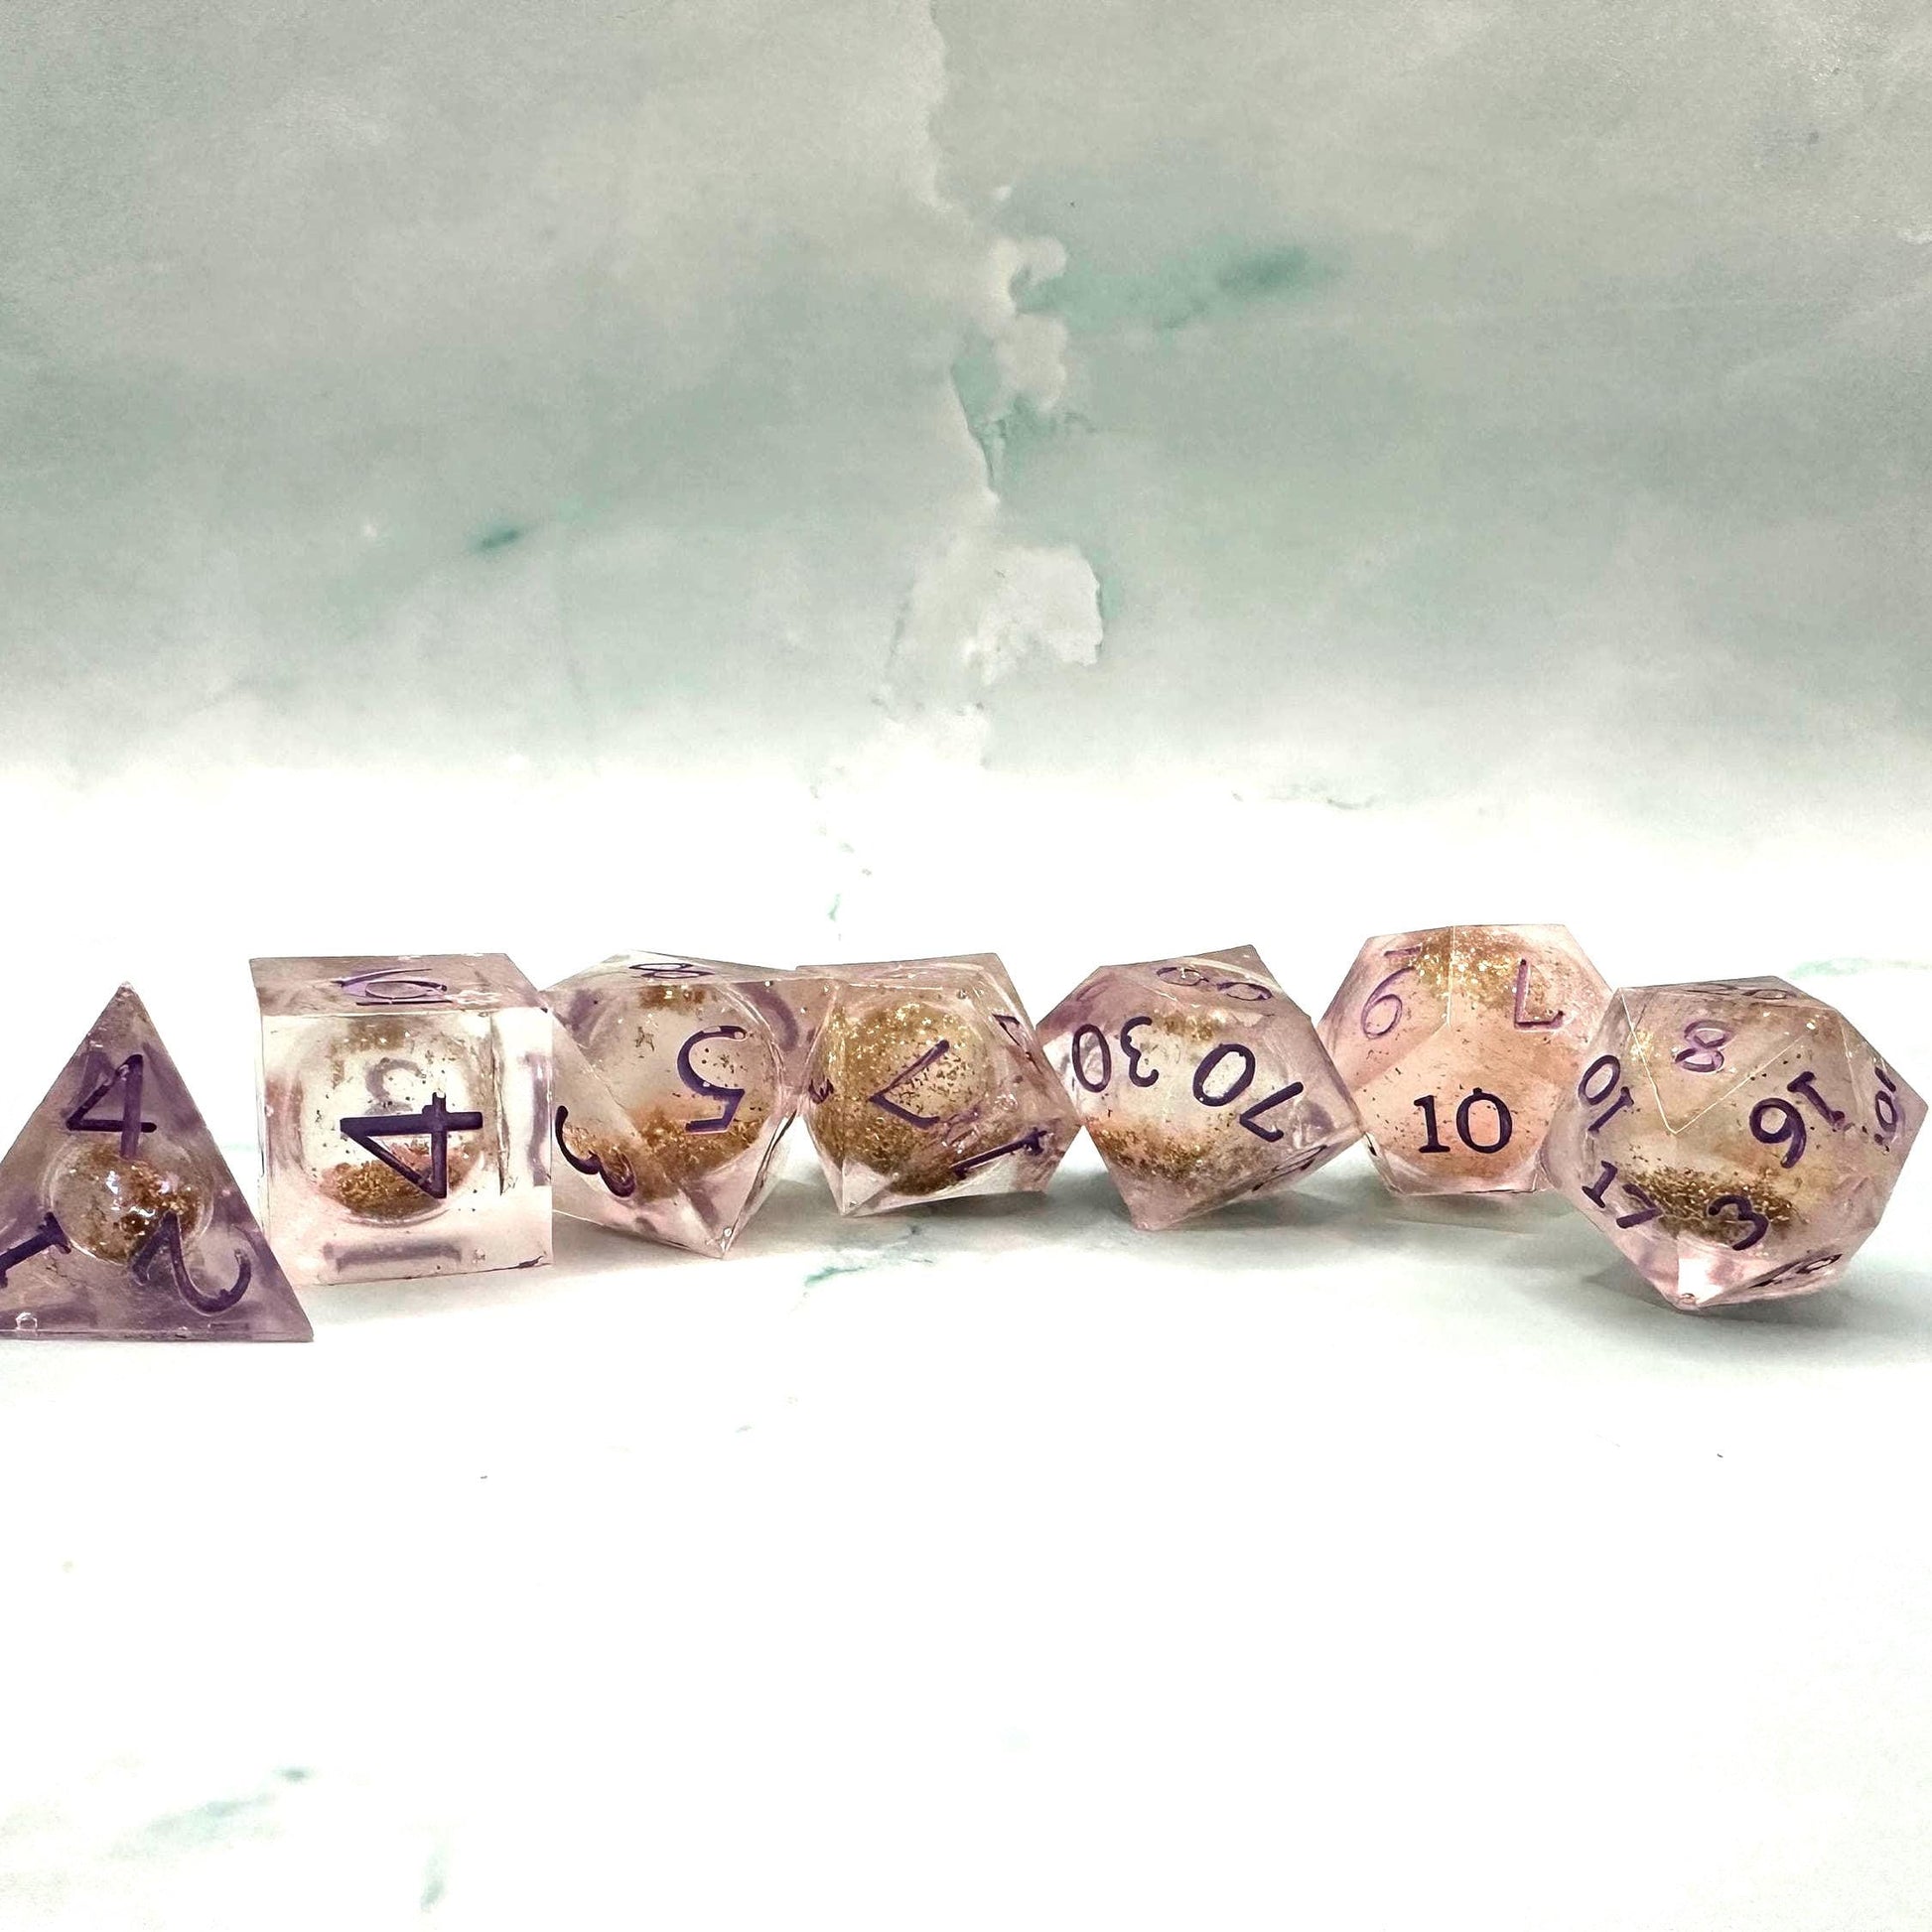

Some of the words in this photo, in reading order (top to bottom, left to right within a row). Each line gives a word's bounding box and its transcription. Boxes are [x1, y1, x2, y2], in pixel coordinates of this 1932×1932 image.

[677, 1025, 747, 1134] 5
[1071, 1016, 1160, 1093] 30
[1675, 1019, 1735, 1073] 8
[66, 1053, 157, 1161] 4
[1193, 1042, 1305, 1143] 70
[1413, 1087, 1513, 1154] 10
[1578, 1054, 1634, 1135] 10
[340, 1092, 483, 1199] 4
[1582, 1160, 1665, 1230] 17
[1708, 1194, 1770, 1252] 3
